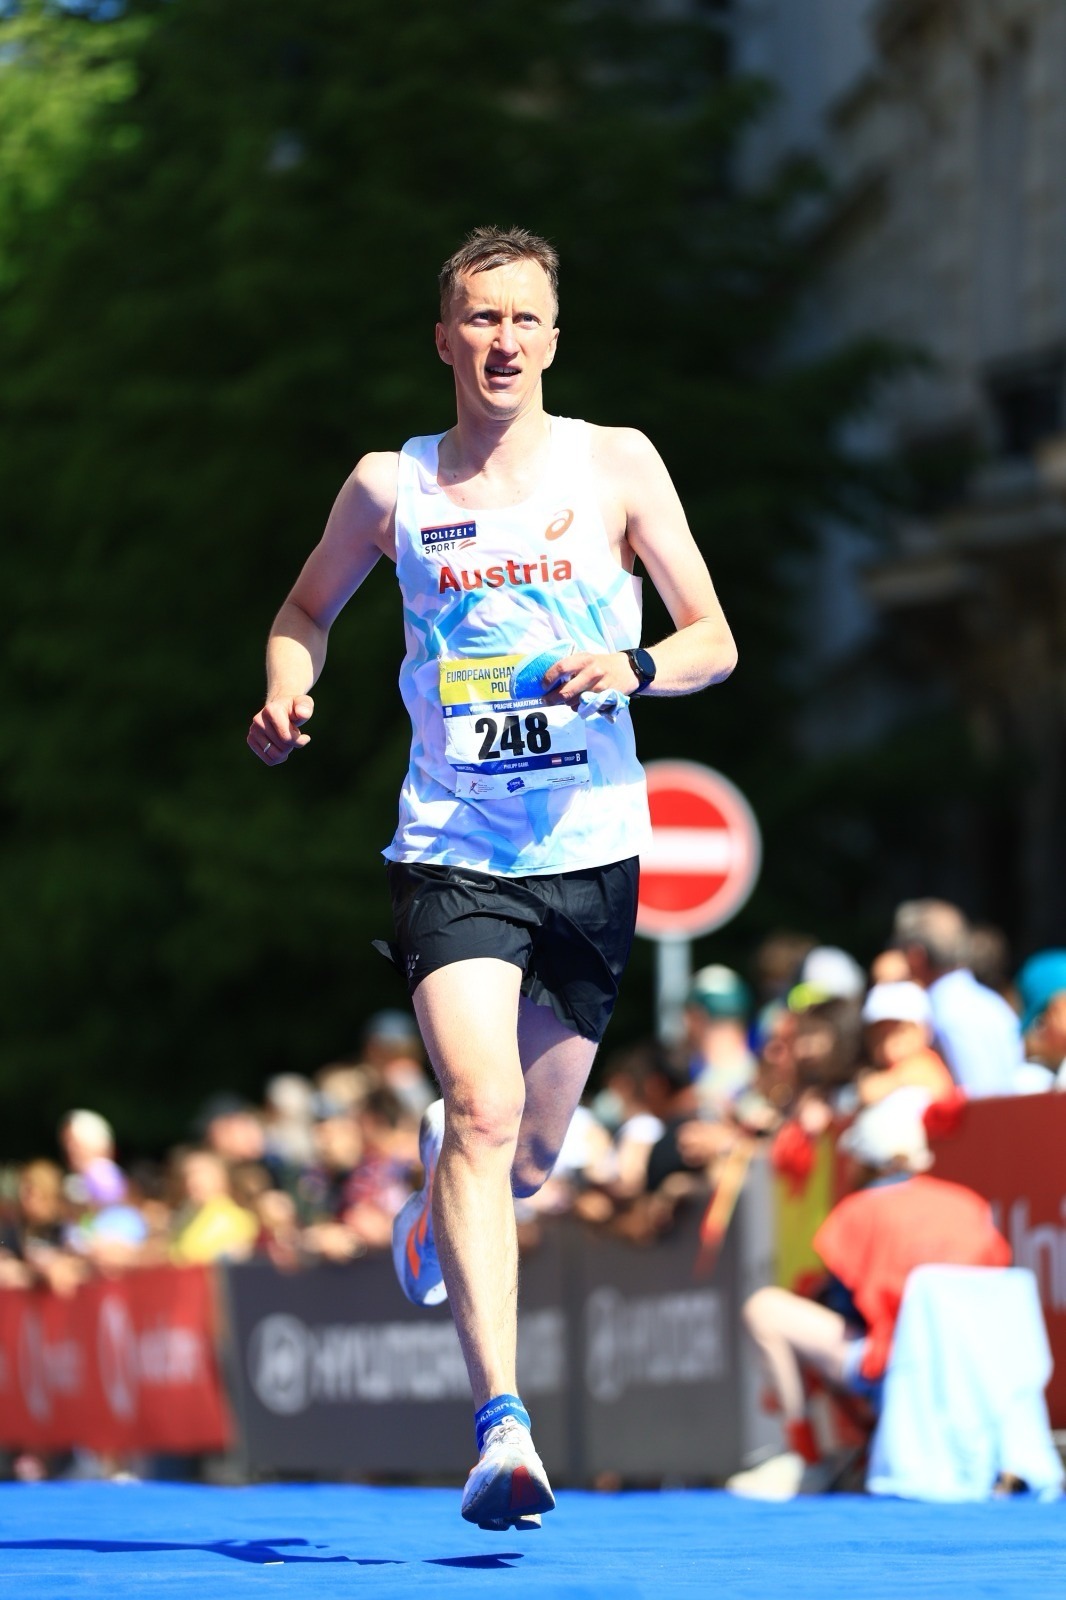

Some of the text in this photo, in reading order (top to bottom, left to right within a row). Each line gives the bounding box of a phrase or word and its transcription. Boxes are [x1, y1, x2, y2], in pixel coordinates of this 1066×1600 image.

[423, 527, 467, 542] POLIZEI
[425, 542, 456, 554] SPORT
[439, 554, 572, 594] Austria
[446, 668, 491, 683] EUROPEAN
[513, 700, 539, 708] MARATHON
[474, 711, 552, 761] 248
